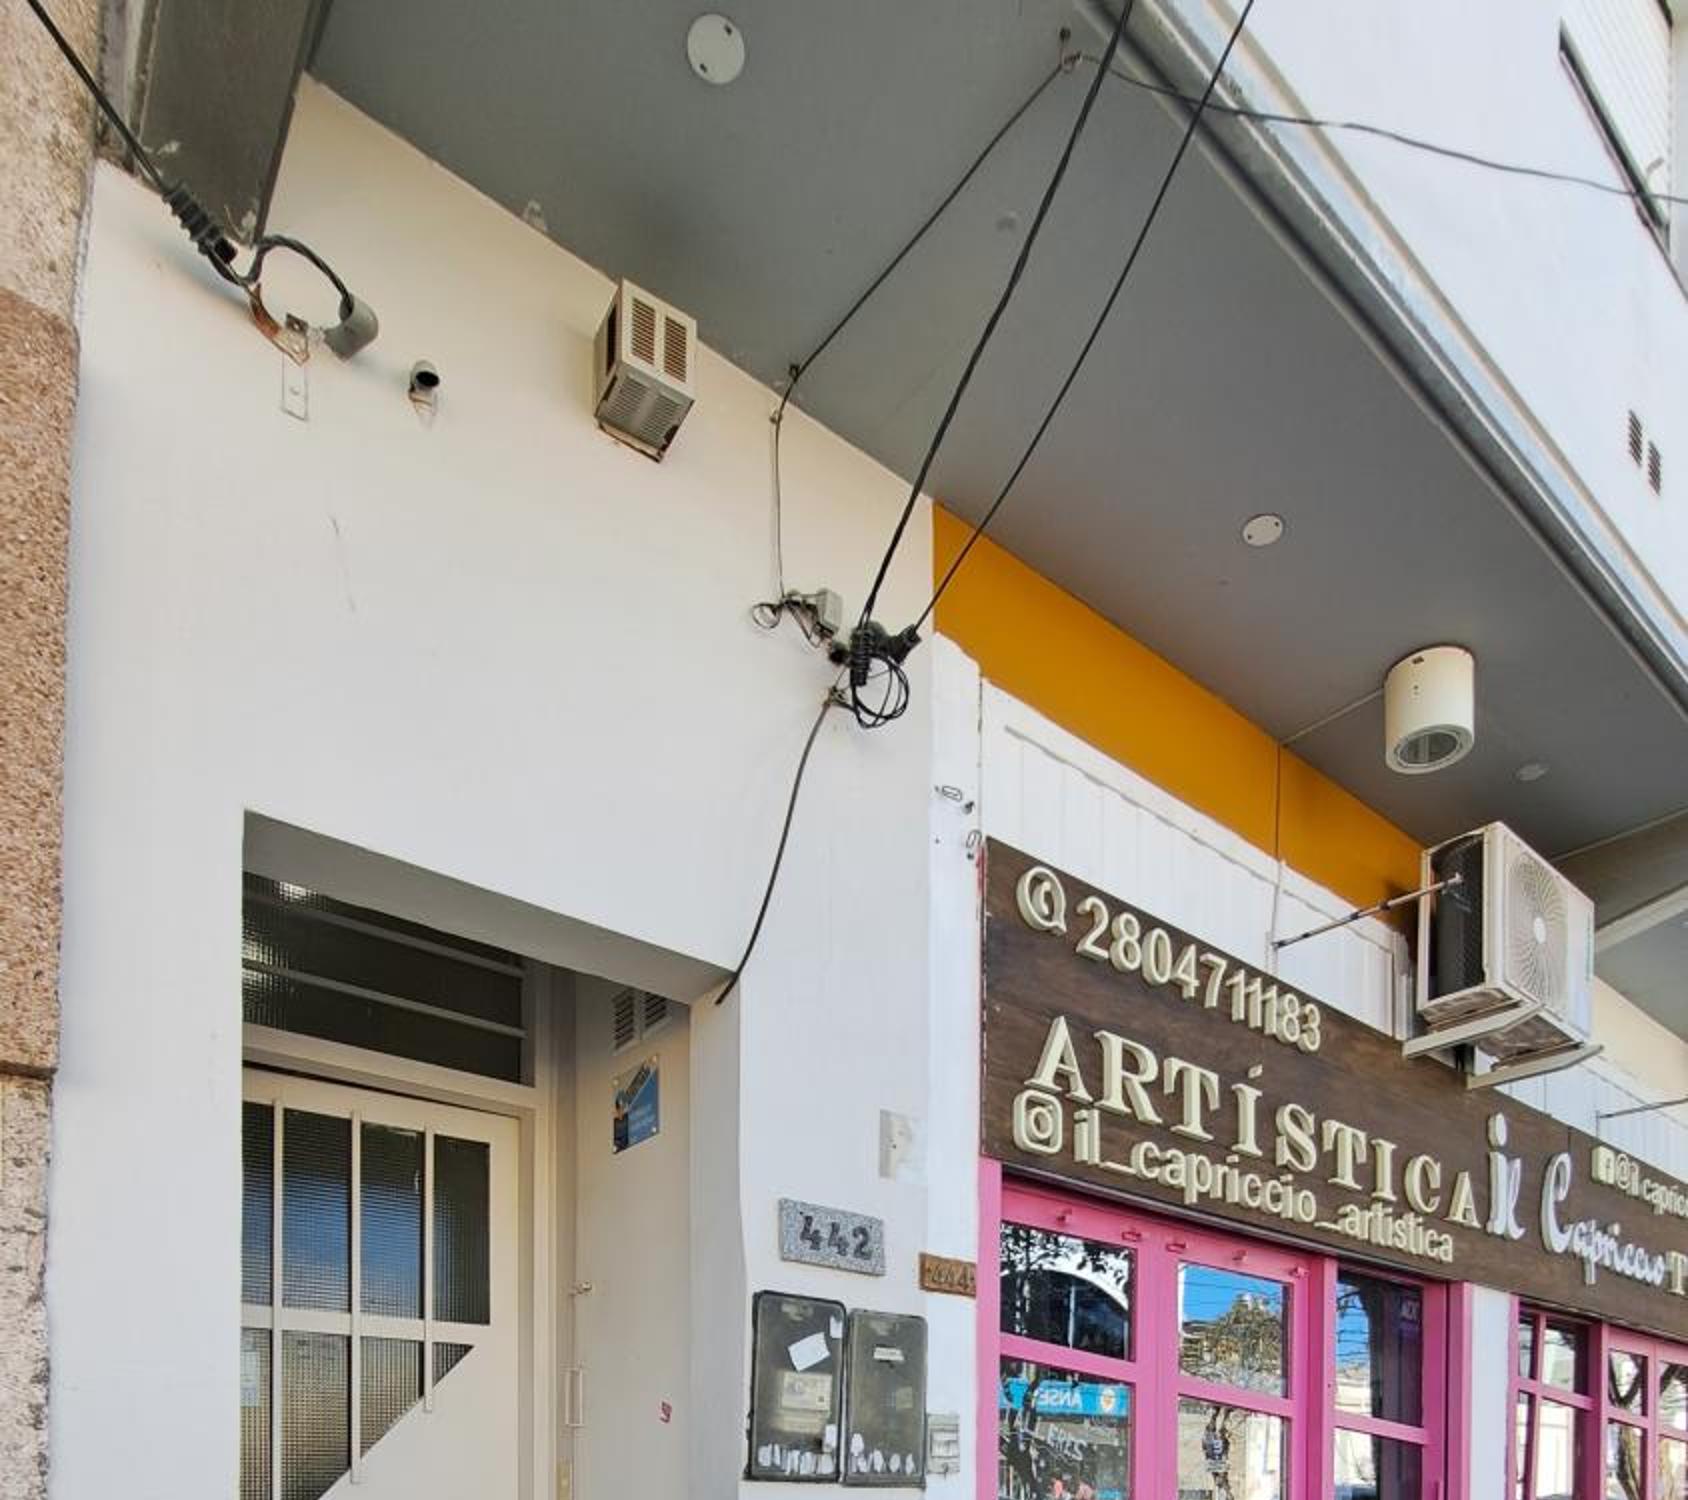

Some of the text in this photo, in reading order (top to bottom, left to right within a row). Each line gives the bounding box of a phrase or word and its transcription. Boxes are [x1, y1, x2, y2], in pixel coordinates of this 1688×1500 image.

[1076, 896, 1321, 1053] 2804711183
[1024, 1016, 1481, 1230] ARTÍSTICA
[800, 1215, 872, 1261] 442
